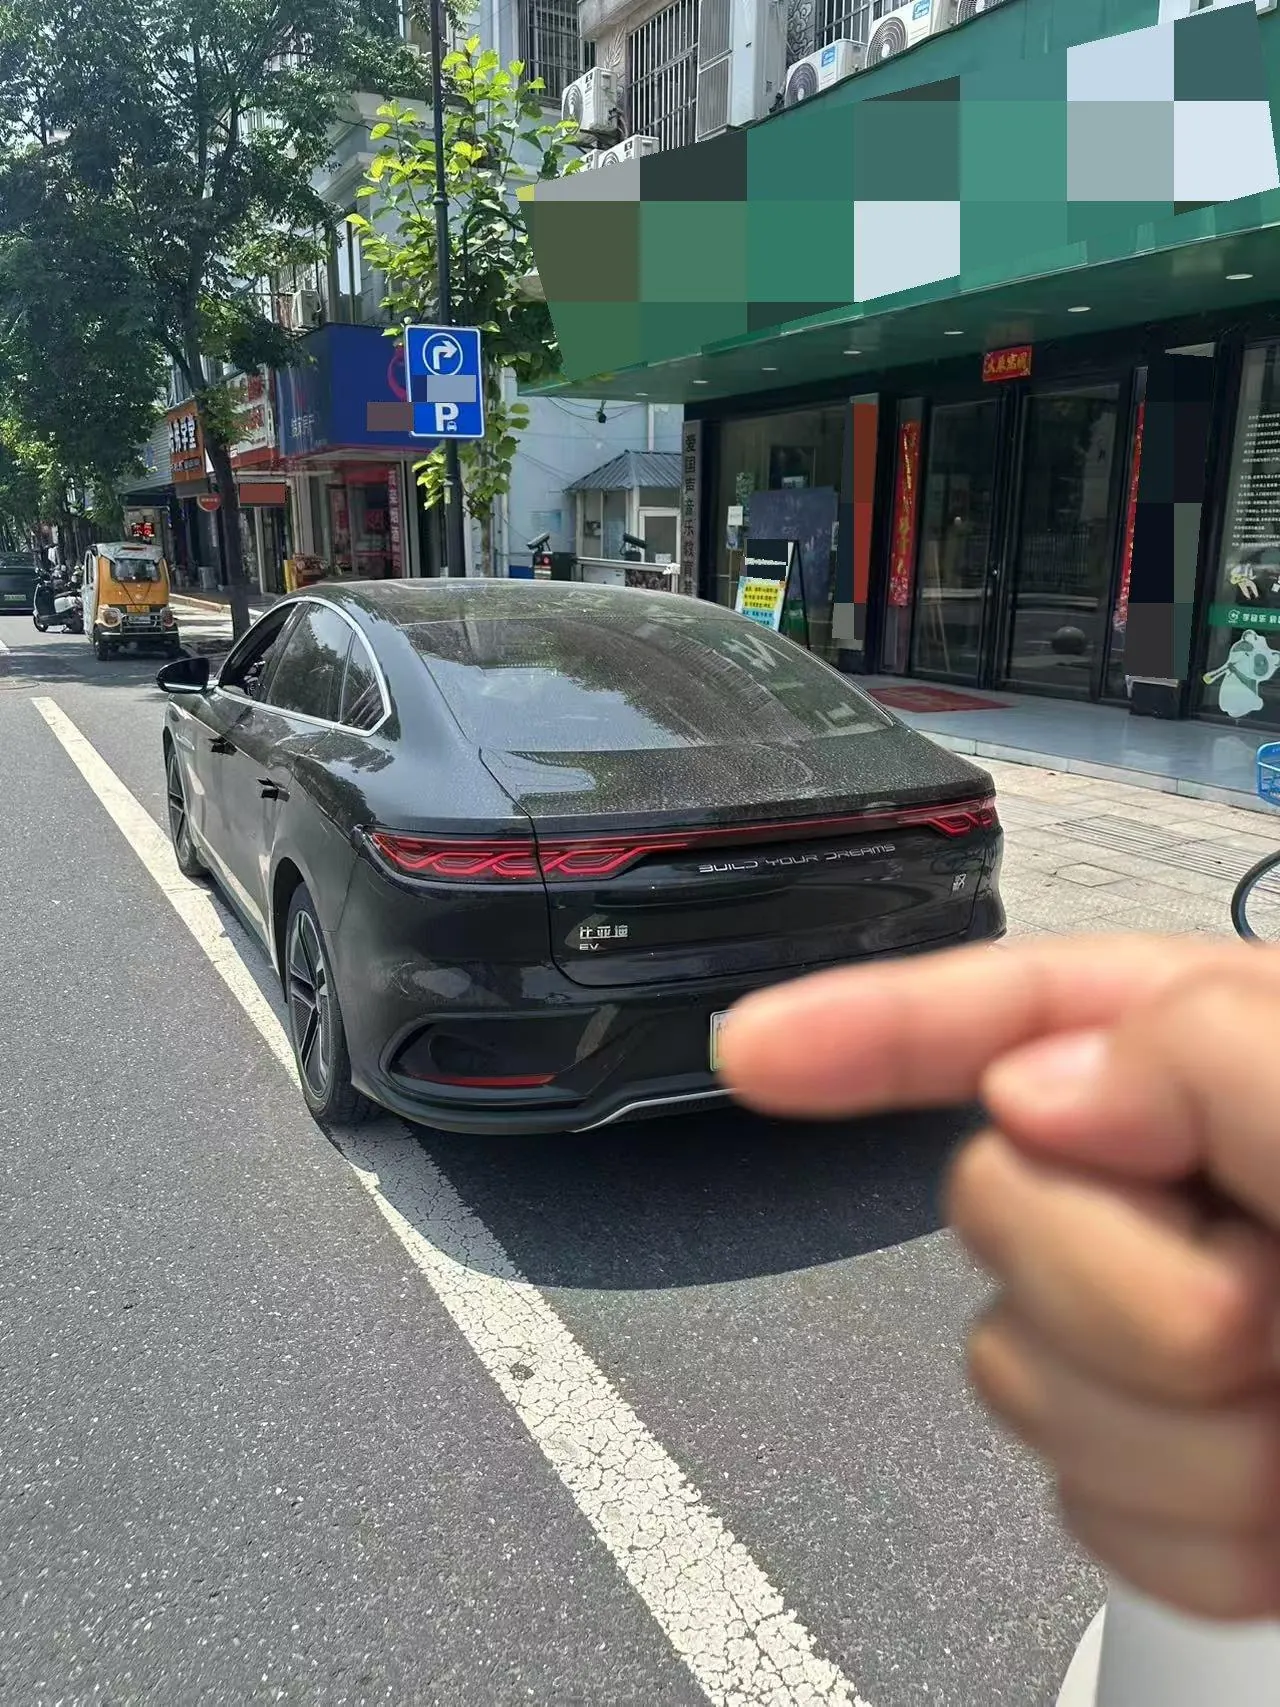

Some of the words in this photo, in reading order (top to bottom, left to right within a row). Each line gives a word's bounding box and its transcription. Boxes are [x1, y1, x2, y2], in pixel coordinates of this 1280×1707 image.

[435, 402, 459, 431] P
[699, 861, 758, 873] BUILD
[765, 854, 819, 866] YOUR
[823, 843, 896, 860] DREAMS
[579, 924, 628, 939] 比亚迪
[579, 943, 599, 951] EV
